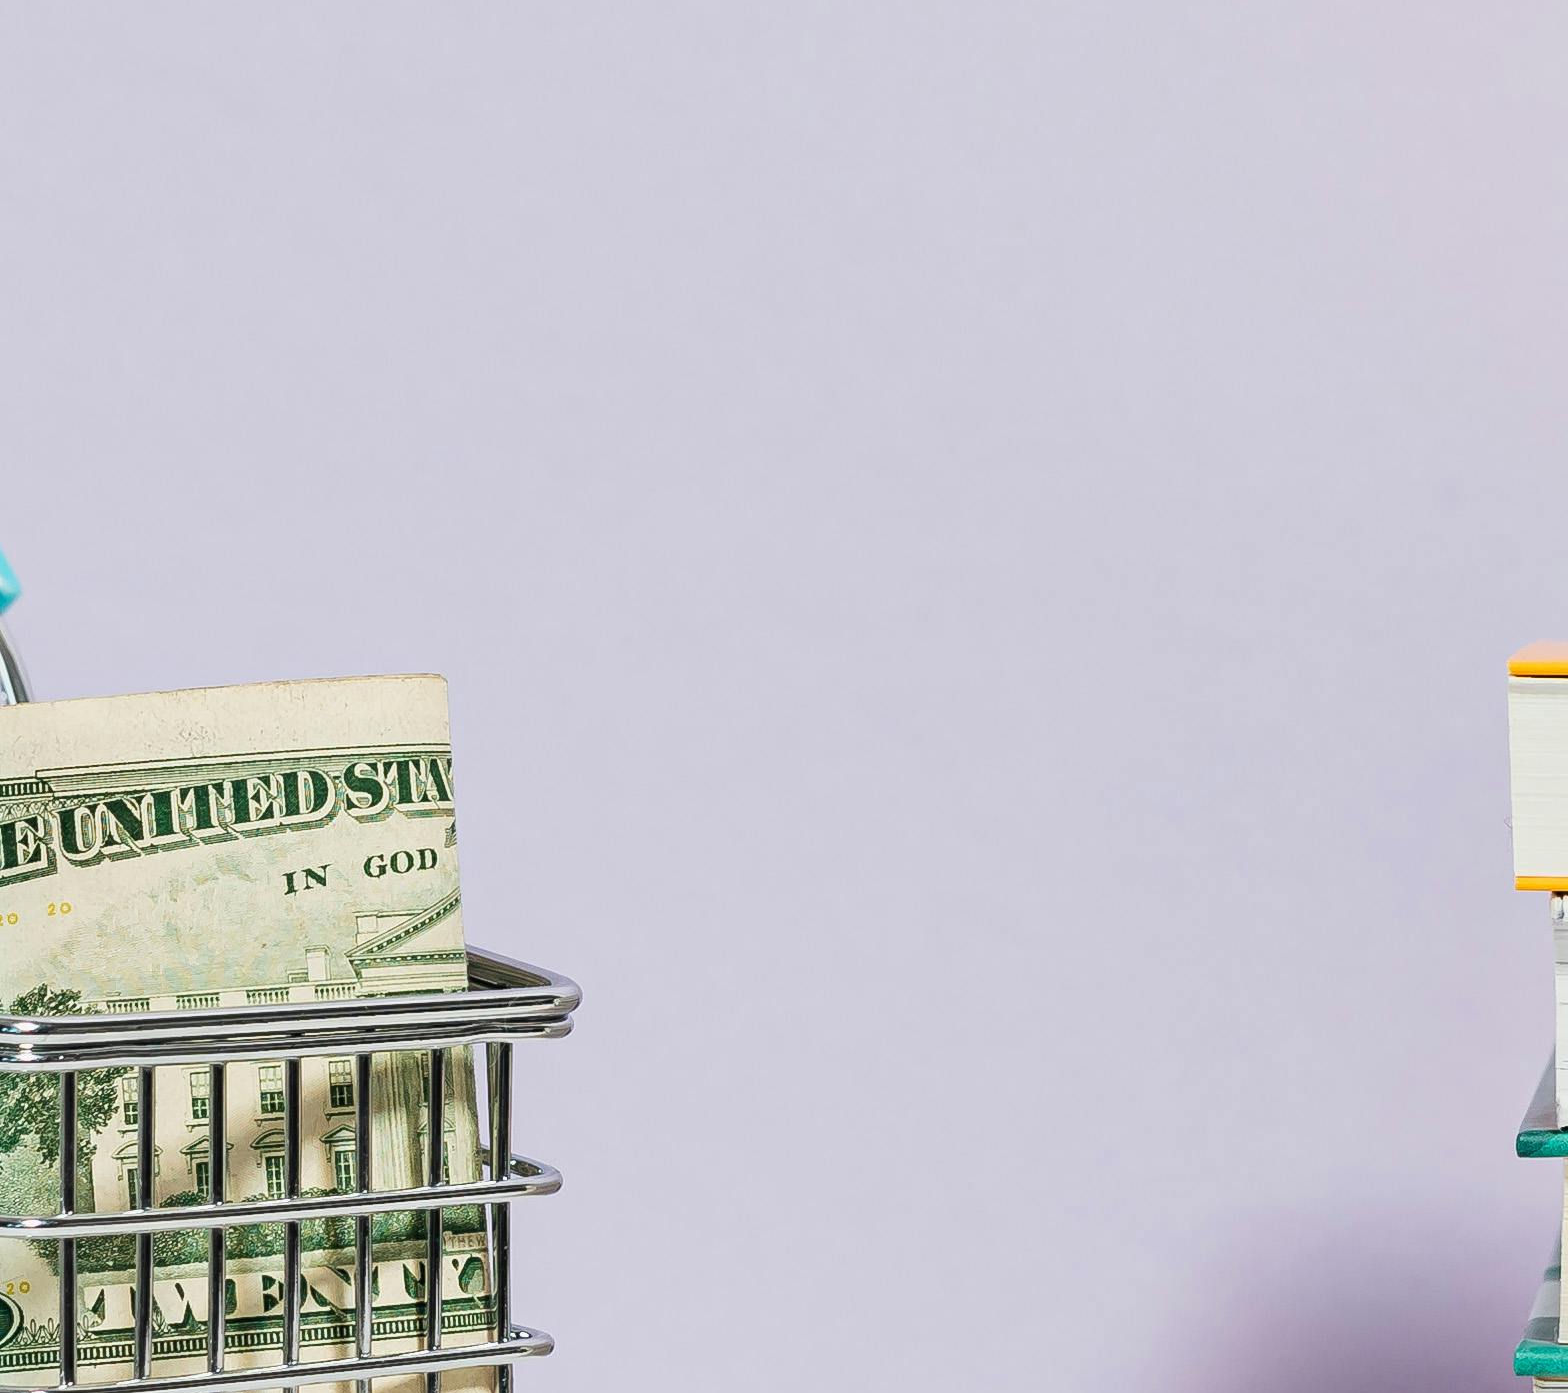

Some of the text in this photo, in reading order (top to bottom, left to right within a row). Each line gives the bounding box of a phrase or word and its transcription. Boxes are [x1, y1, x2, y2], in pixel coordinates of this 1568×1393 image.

[54, 766, 338, 868] UNITED
[341, 755, 454, 823] STA
[282, 847, 439, 896] IN GOD
[48, 902, 72, 916] 20
[6, 1279, 31, 1295] 20
